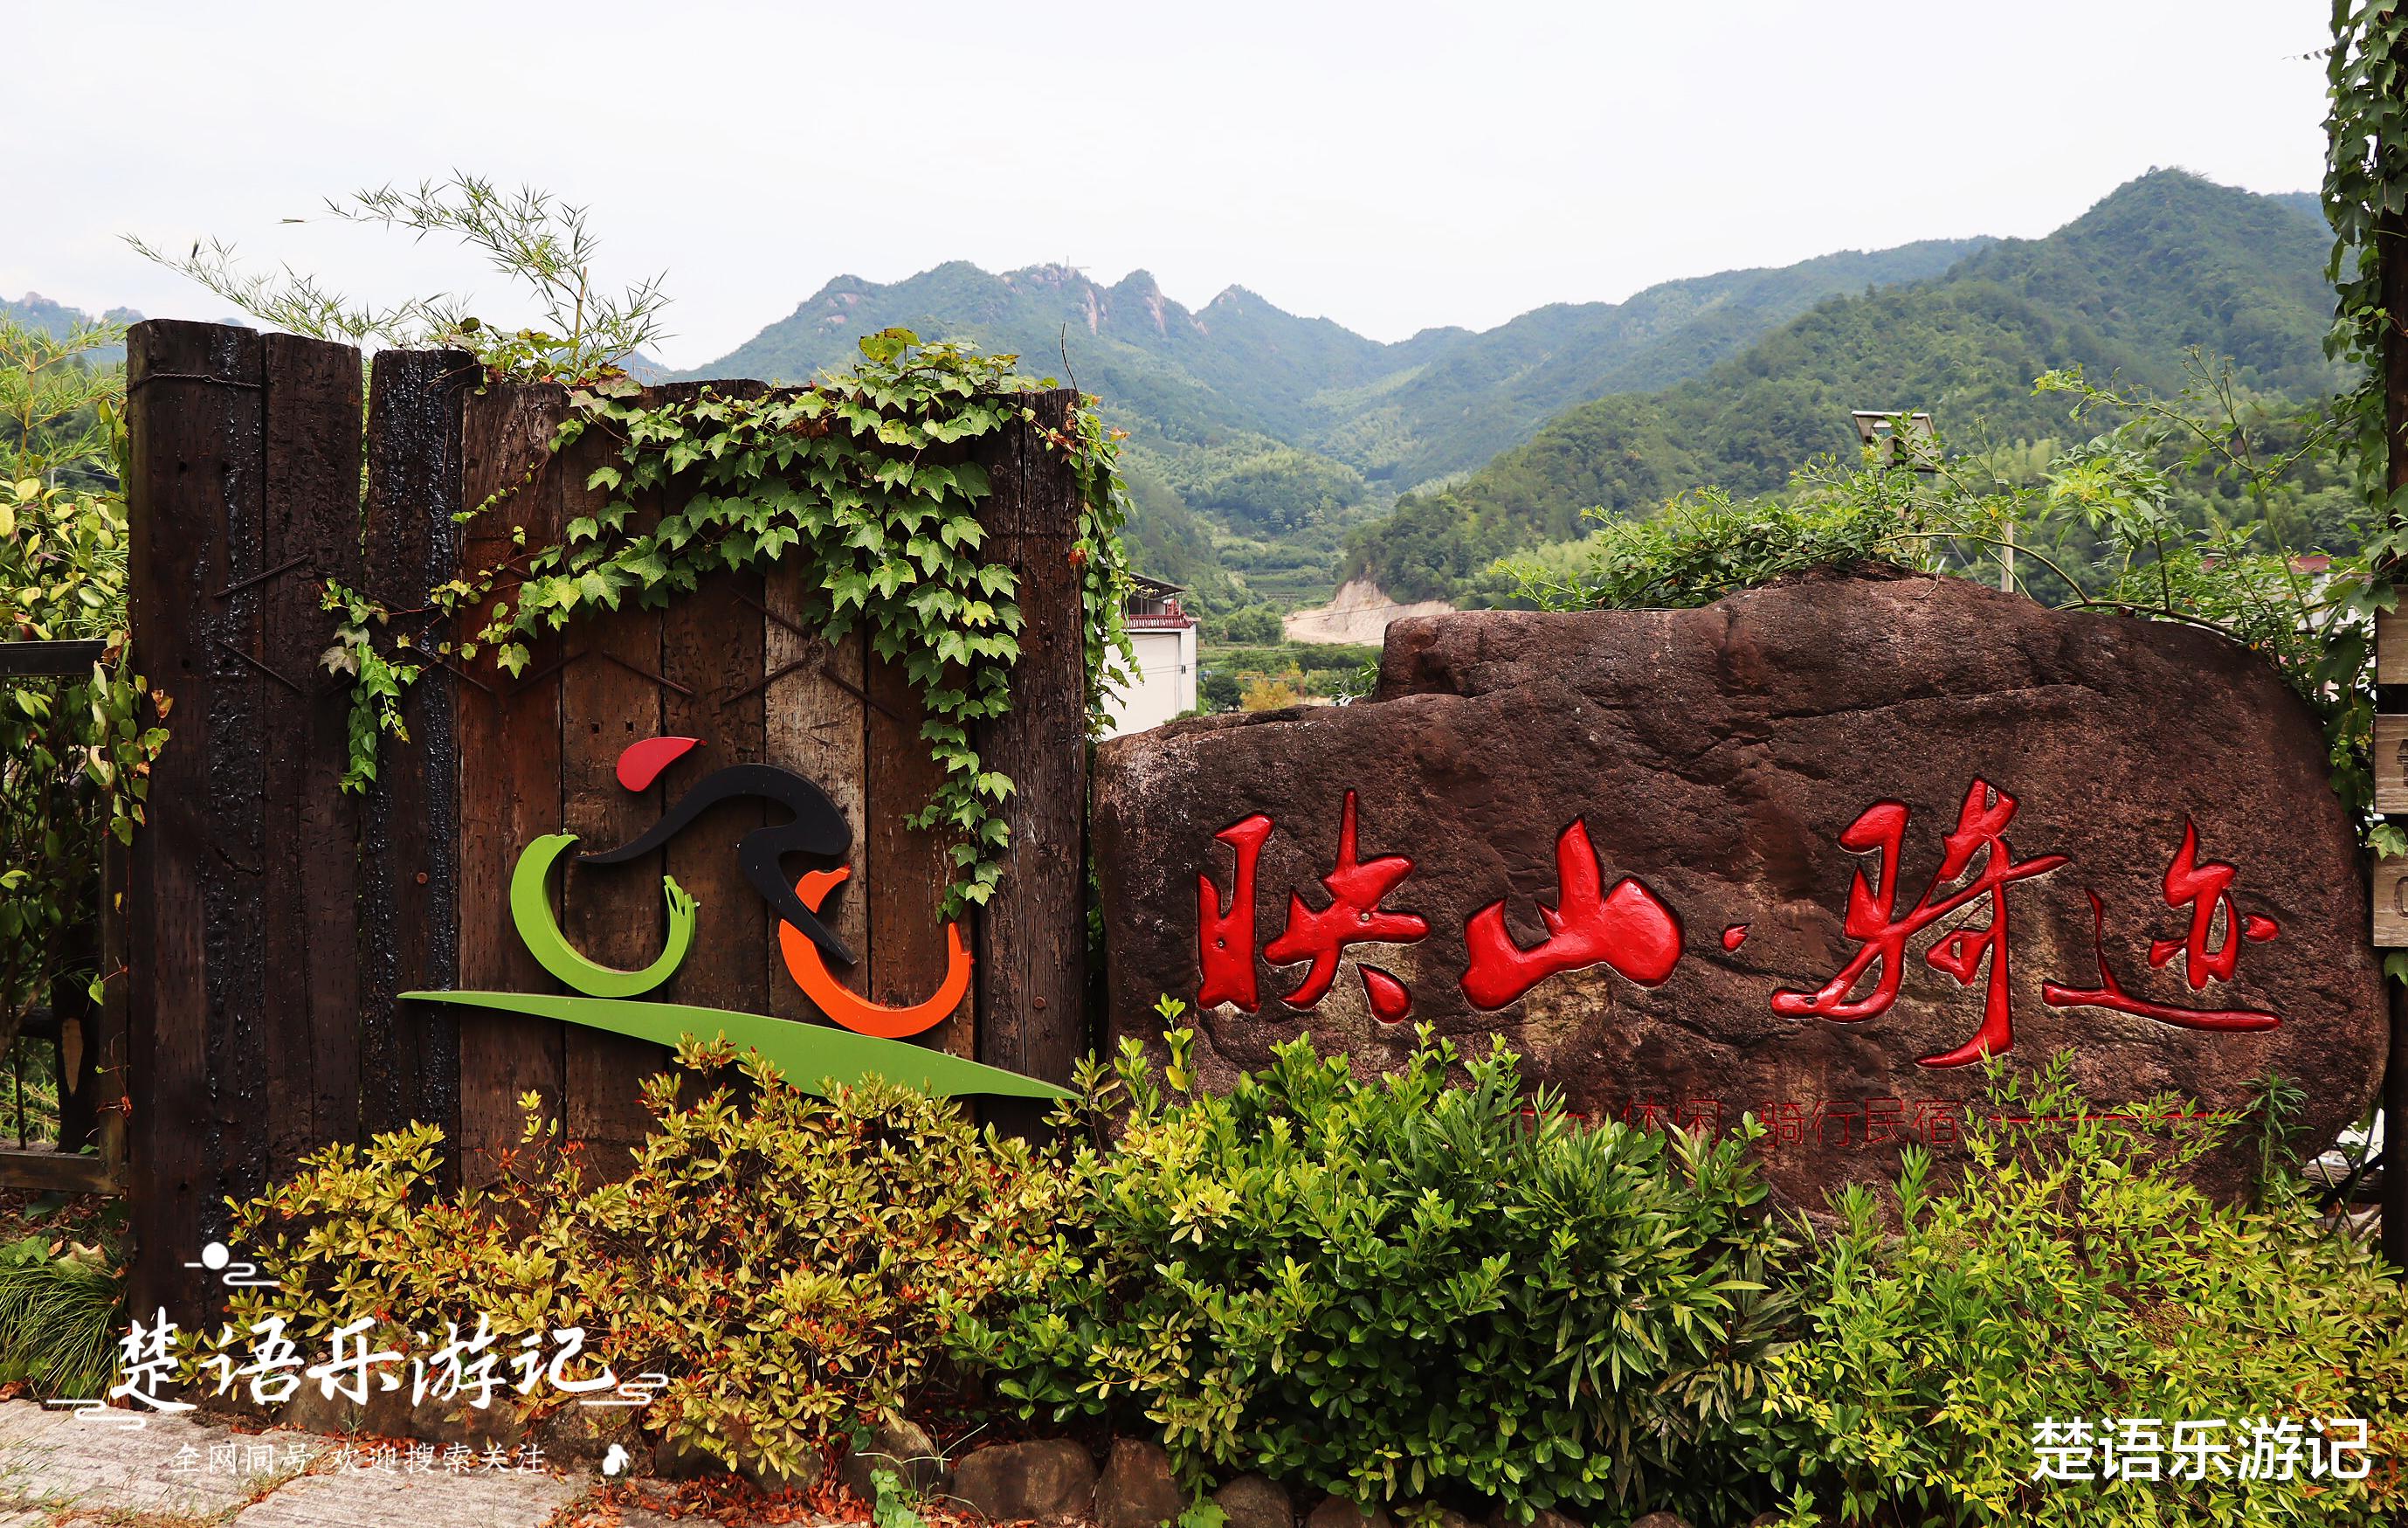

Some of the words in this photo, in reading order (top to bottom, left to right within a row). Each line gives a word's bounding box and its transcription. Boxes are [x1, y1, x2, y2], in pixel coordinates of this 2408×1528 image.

[1620, 1094, 1721, 1144] 休闲
[1760, 1096, 1963, 1148] 骑行民宿
